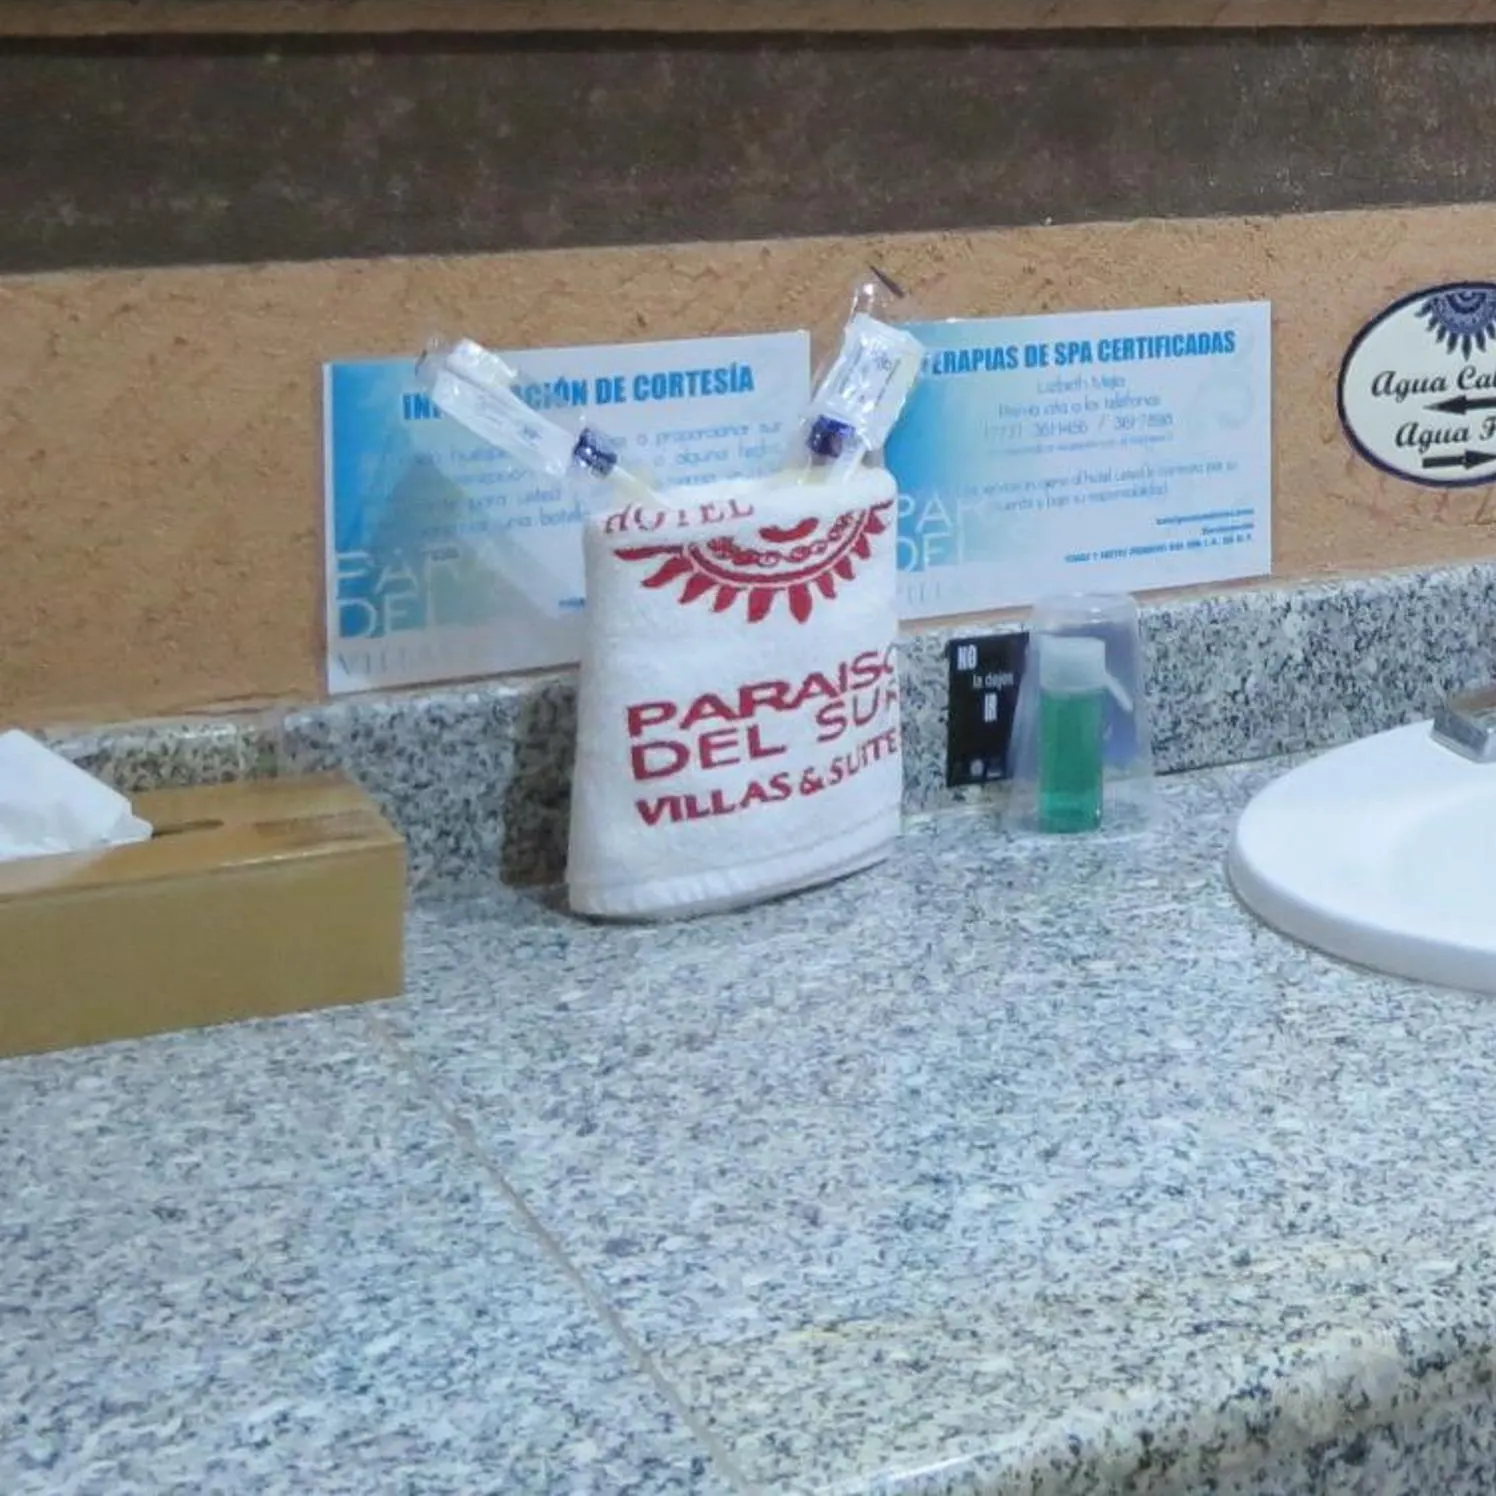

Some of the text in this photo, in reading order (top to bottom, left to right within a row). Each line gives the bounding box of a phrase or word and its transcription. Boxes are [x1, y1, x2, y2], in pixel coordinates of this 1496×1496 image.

[1025, 343, 1050, 368] DE
[1054, 339, 1094, 366] SPA
[1097, 329, 1237, 363] CERTIFICADAS
[595, 375, 627, 405] DE
[632, 361, 755, 402] CORTESÍA
[1370, 369, 1448, 404] Agua
[1394, 420, 1473, 453] Agua
[630, 724, 787, 781] DEL
[635, 770, 793, 827] VILLAS
